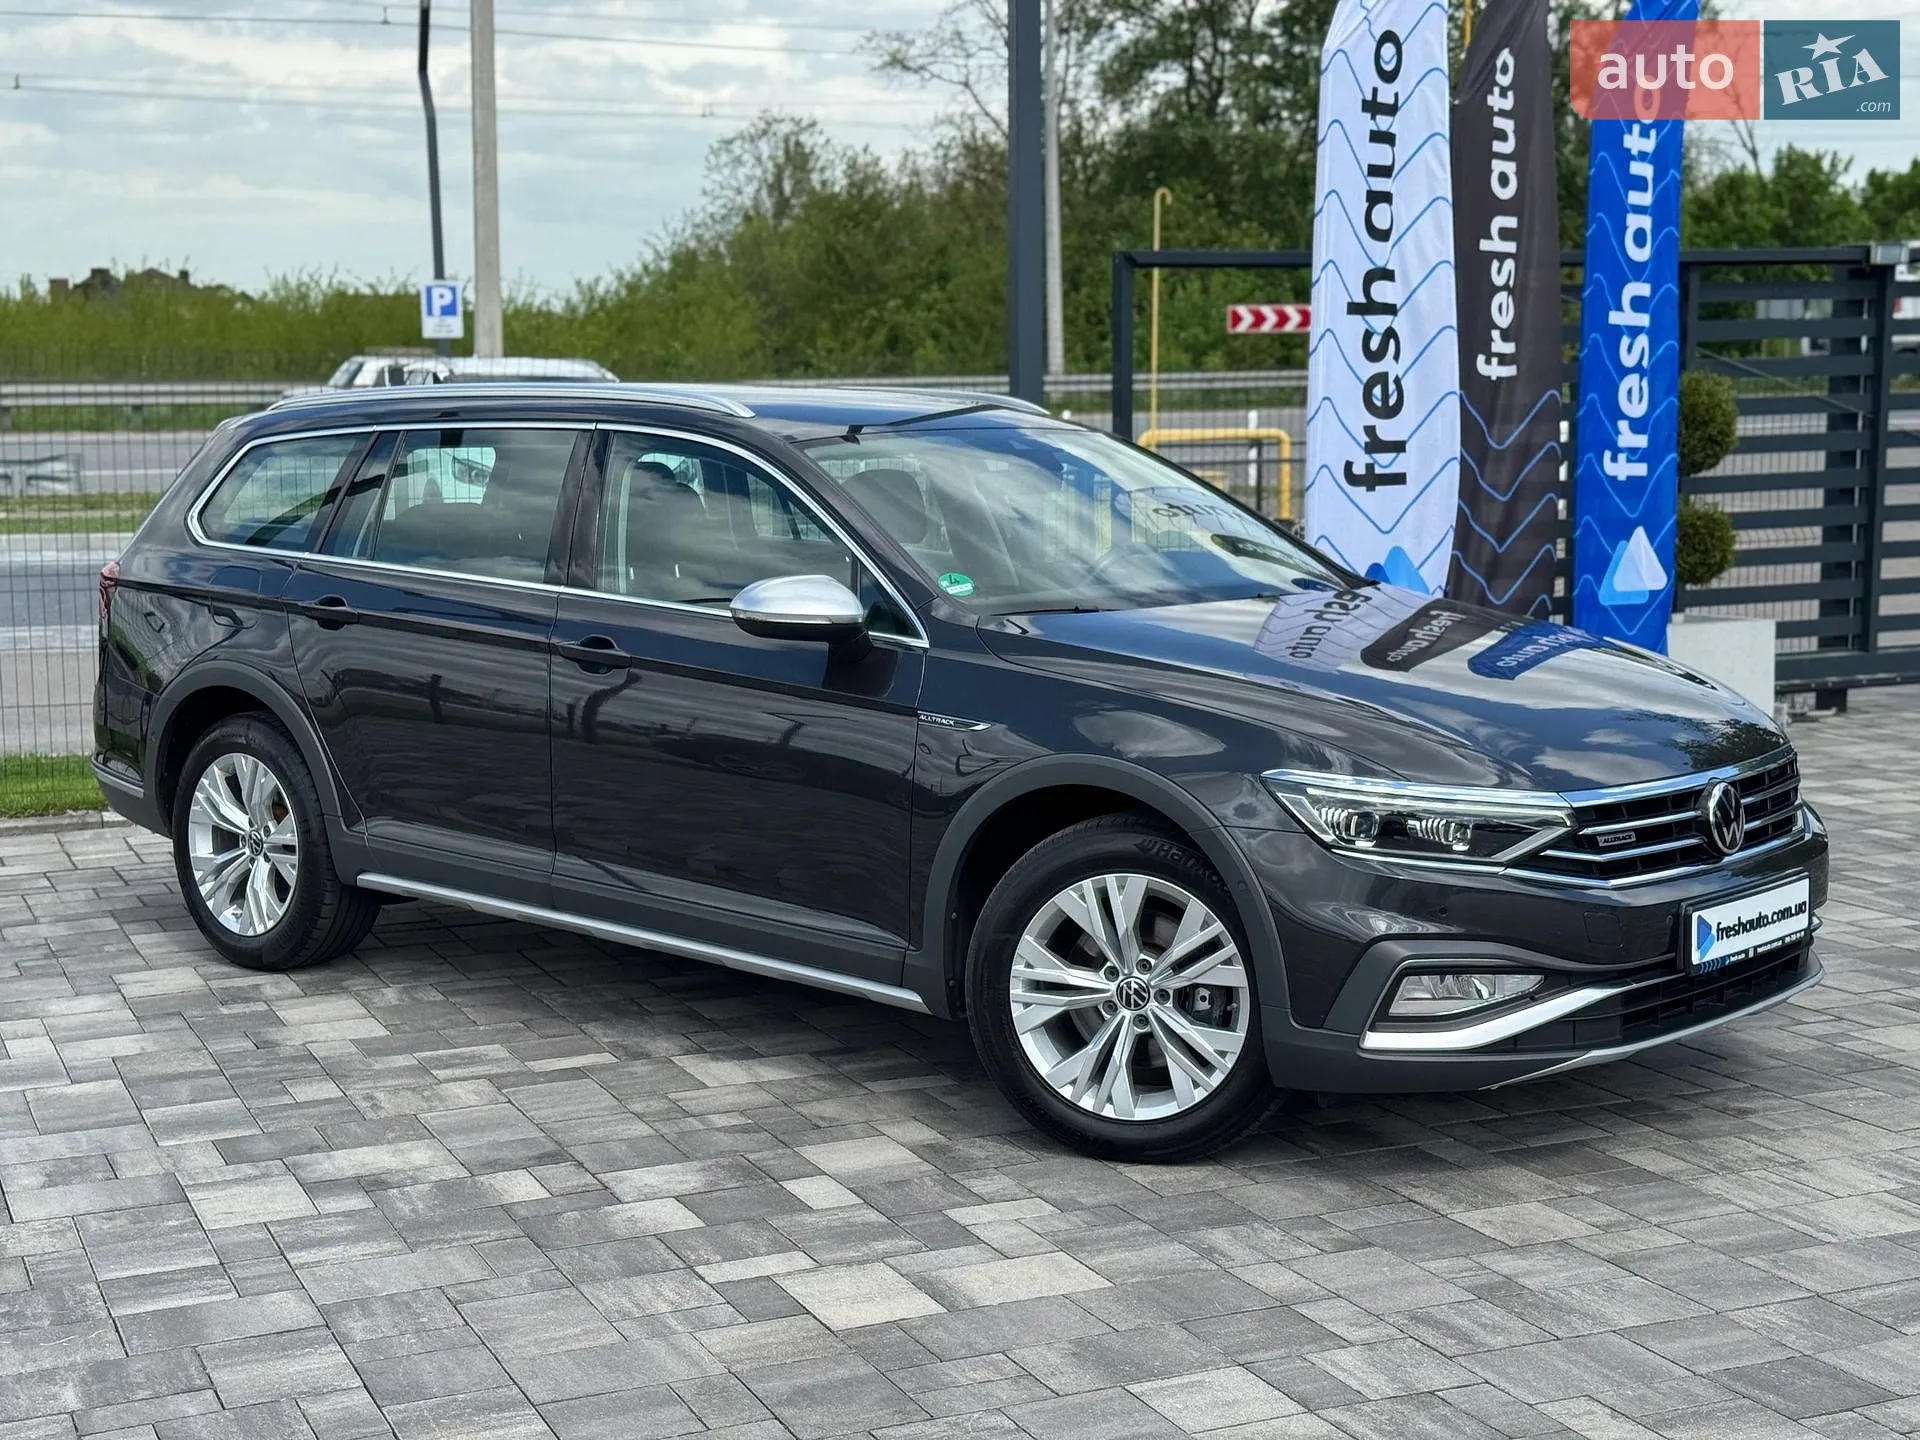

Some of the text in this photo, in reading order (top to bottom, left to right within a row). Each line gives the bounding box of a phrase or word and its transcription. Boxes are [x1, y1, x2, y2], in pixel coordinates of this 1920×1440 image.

[431, 287, 453, 316] P
[1343, 29, 1408, 493] fresh auto
[1476, 47, 1519, 381] fresh auto
[1603, 75, 1661, 482] fresh auto
[920, 714, 955, 727] ALLTRACK
[1715, 900, 1807, 942] freshauto.com.ua
